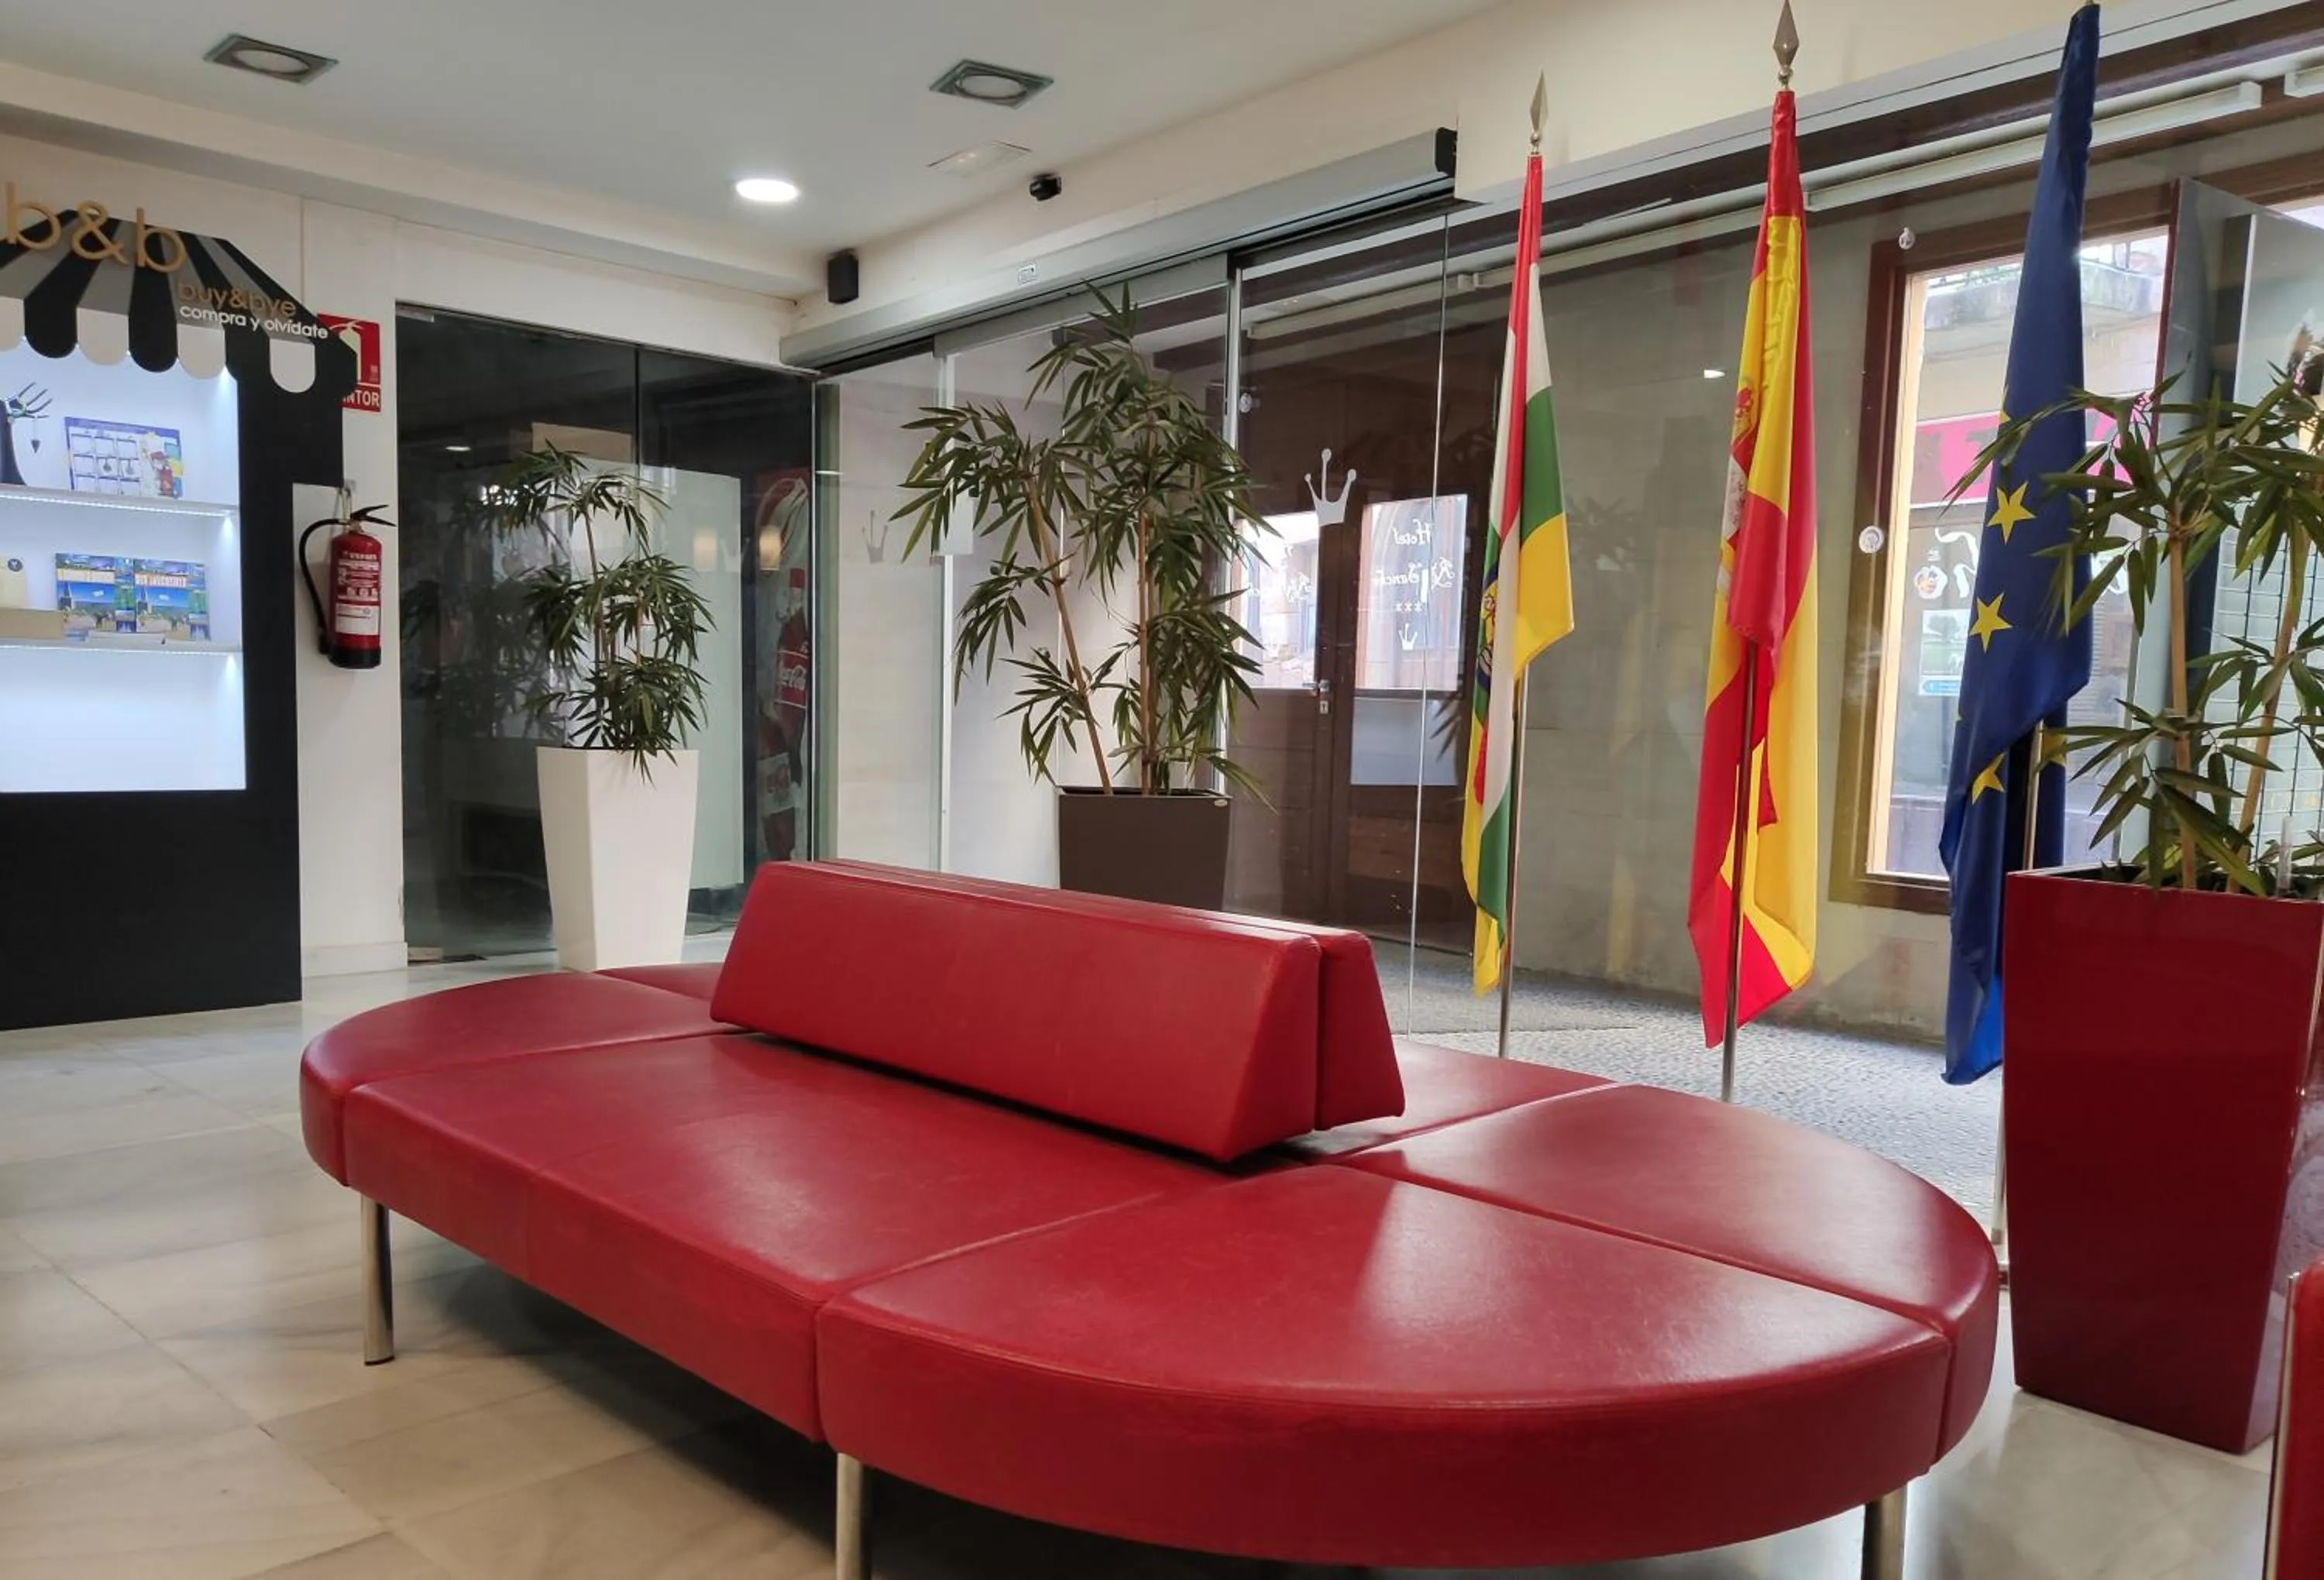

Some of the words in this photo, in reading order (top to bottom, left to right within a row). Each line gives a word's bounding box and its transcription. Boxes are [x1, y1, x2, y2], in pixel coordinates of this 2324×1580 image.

[6, 181, 186, 273] b&b
[179, 283, 296, 318] buy&bye
[180, 306, 246, 326] compra
[250, 318, 260, 331] y
